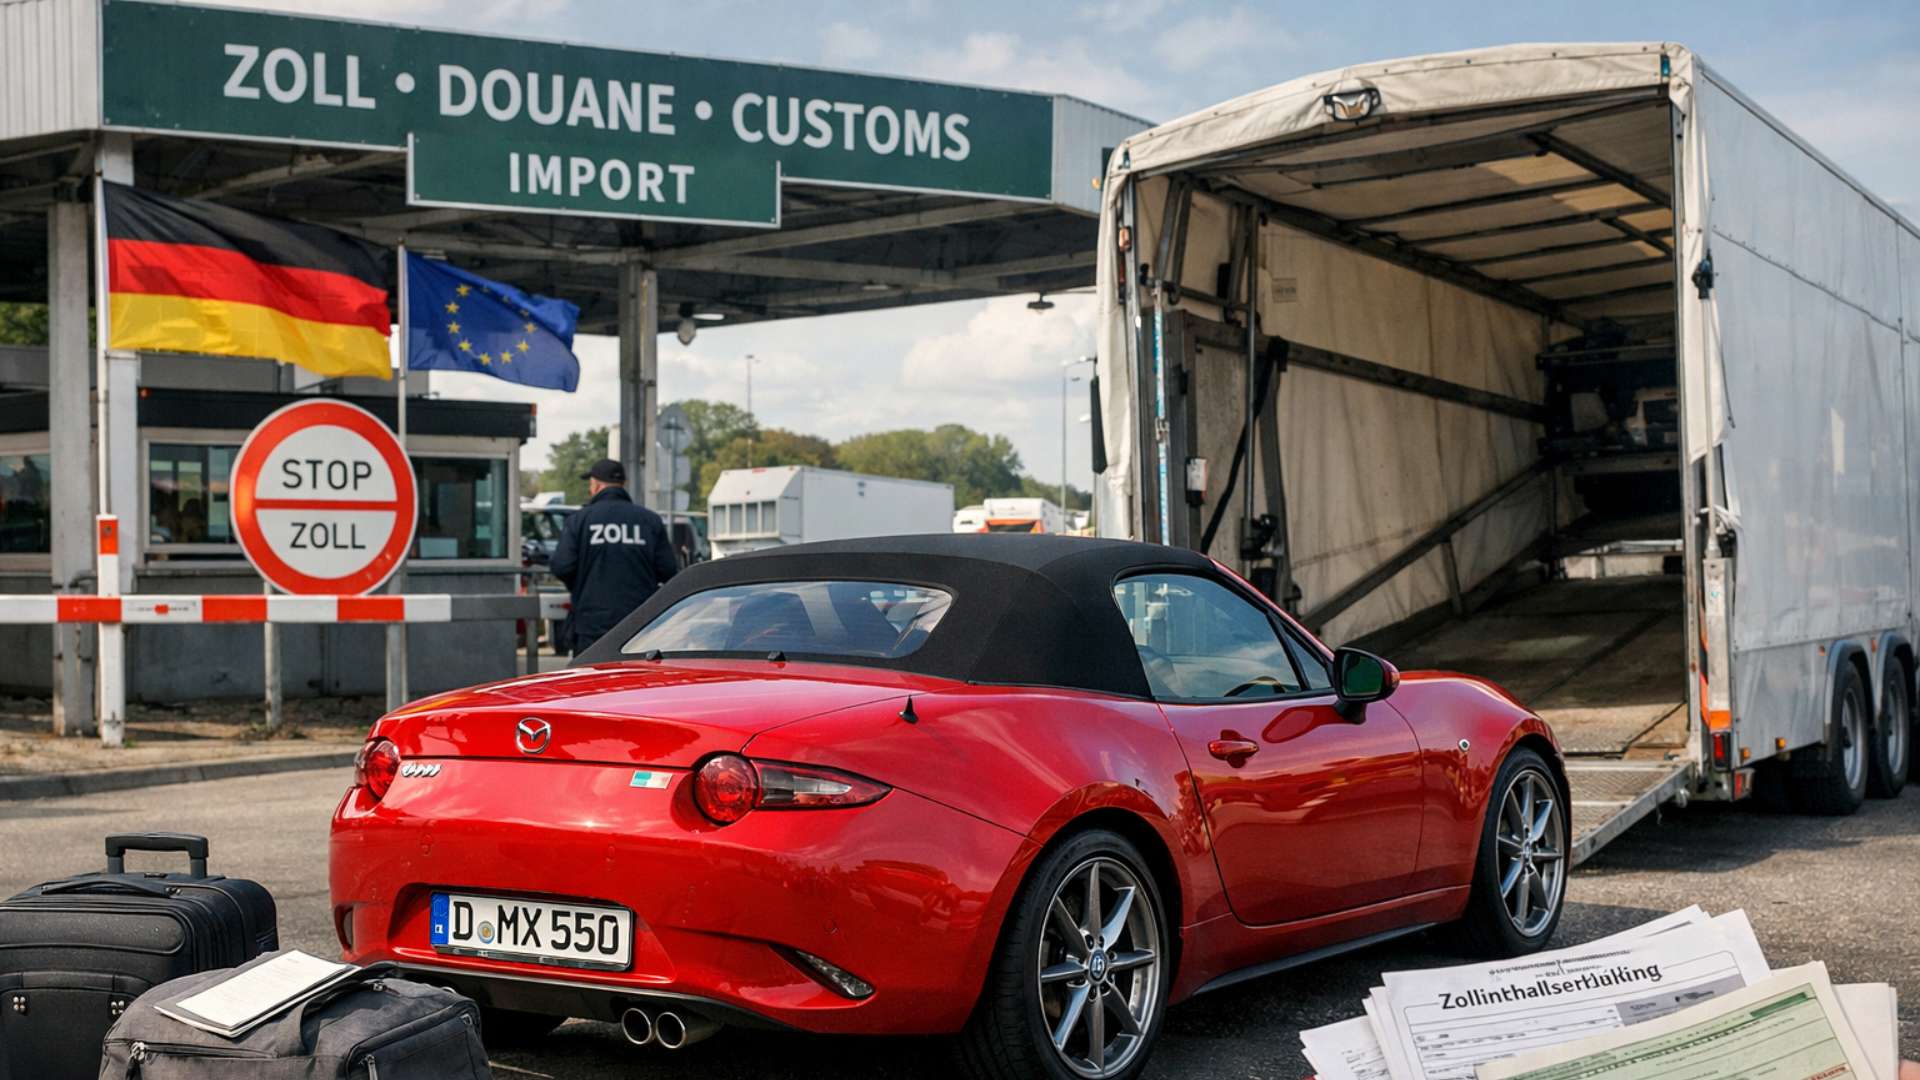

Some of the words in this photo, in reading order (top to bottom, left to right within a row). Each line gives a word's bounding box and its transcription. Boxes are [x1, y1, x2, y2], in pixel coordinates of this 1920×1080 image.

[223, 43, 376, 109] ZOLL
[438, 64, 676, 135] DOUANE
[731, 92, 971, 162] CUSTOMS
[509, 152, 695, 204] IMPORT
[282, 458, 372, 490] STOP
[290, 522, 366, 549] ZOLL
[589, 523, 646, 545] ZOLL
[453, 901, 474, 940] D
[497, 904, 543, 948] MX
[551, 910, 619, 955] 550
